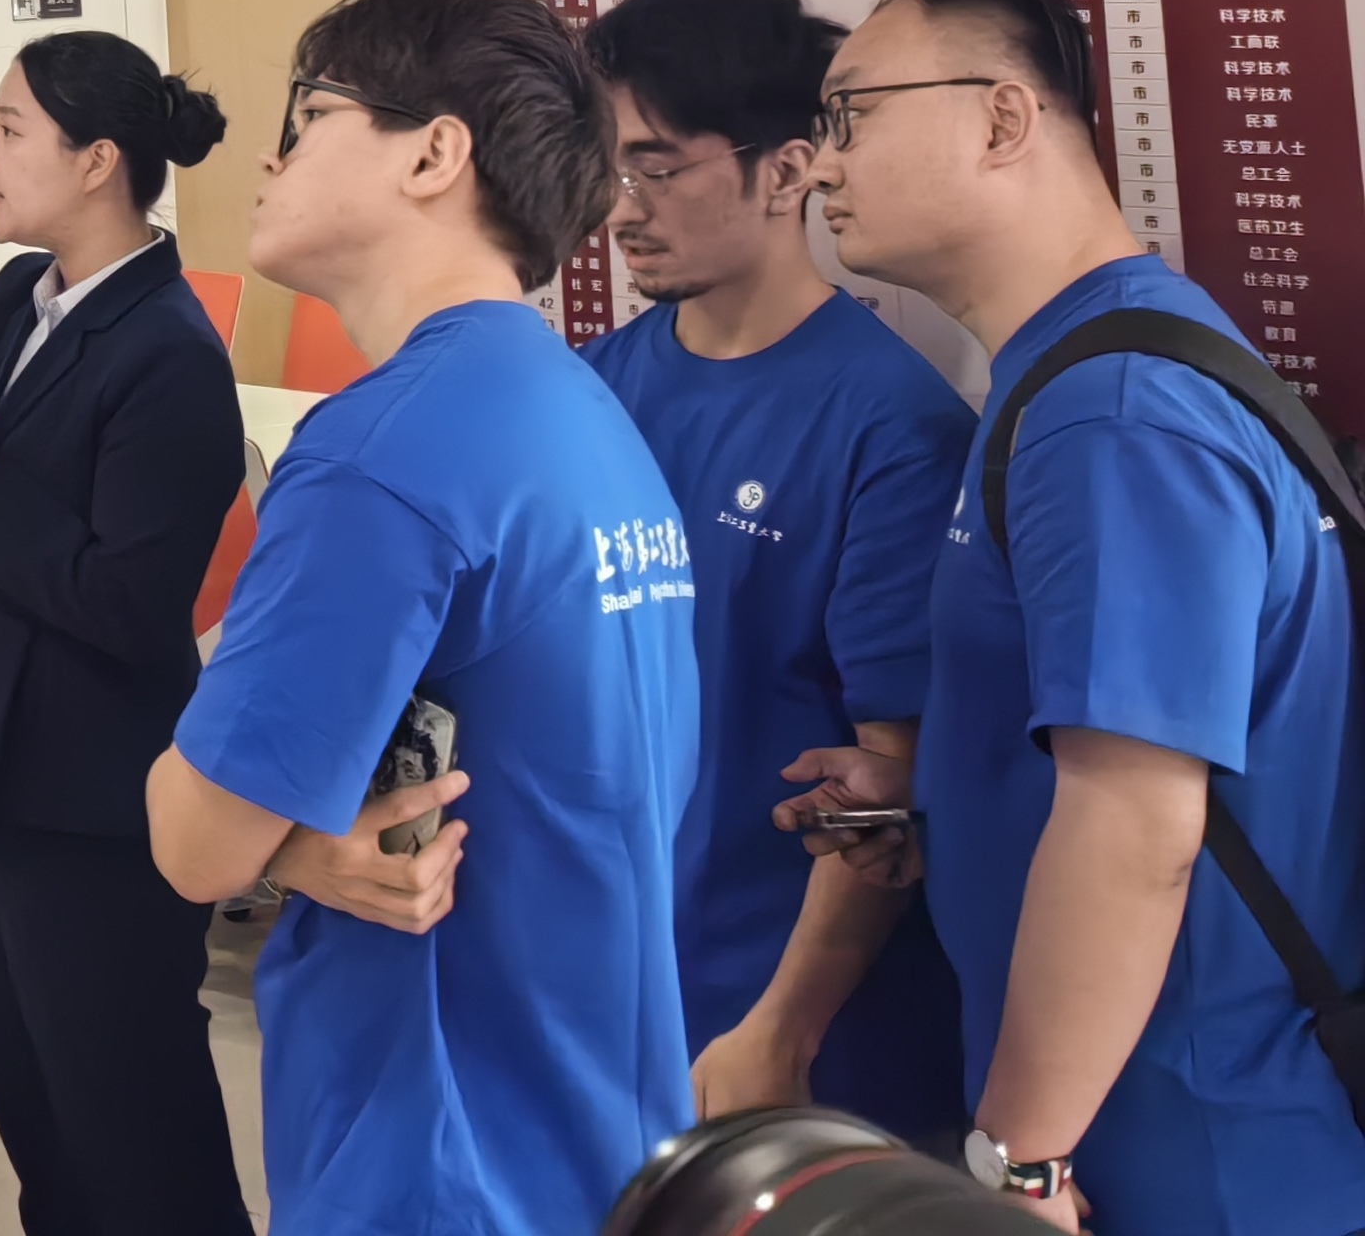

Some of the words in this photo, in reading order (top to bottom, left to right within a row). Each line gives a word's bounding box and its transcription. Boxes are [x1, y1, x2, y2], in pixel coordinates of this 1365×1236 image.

[1220, 9, 1285, 22] 科学技术
[1231, 35, 1279, 49] 工商联
[1226, 87, 1292, 102] 科学技术
[1136, 112, 1149, 126] 市
[1245, 114, 1277, 128] 民革
[1223, 140, 1305, 155] 无党派人士
[1242, 167, 1290, 181] 总工会
[1238, 219, 1304, 235] 医药卫生
[1249, 246, 1298, 262] 总工会
[1244, 272, 1309, 289] 社会科学
